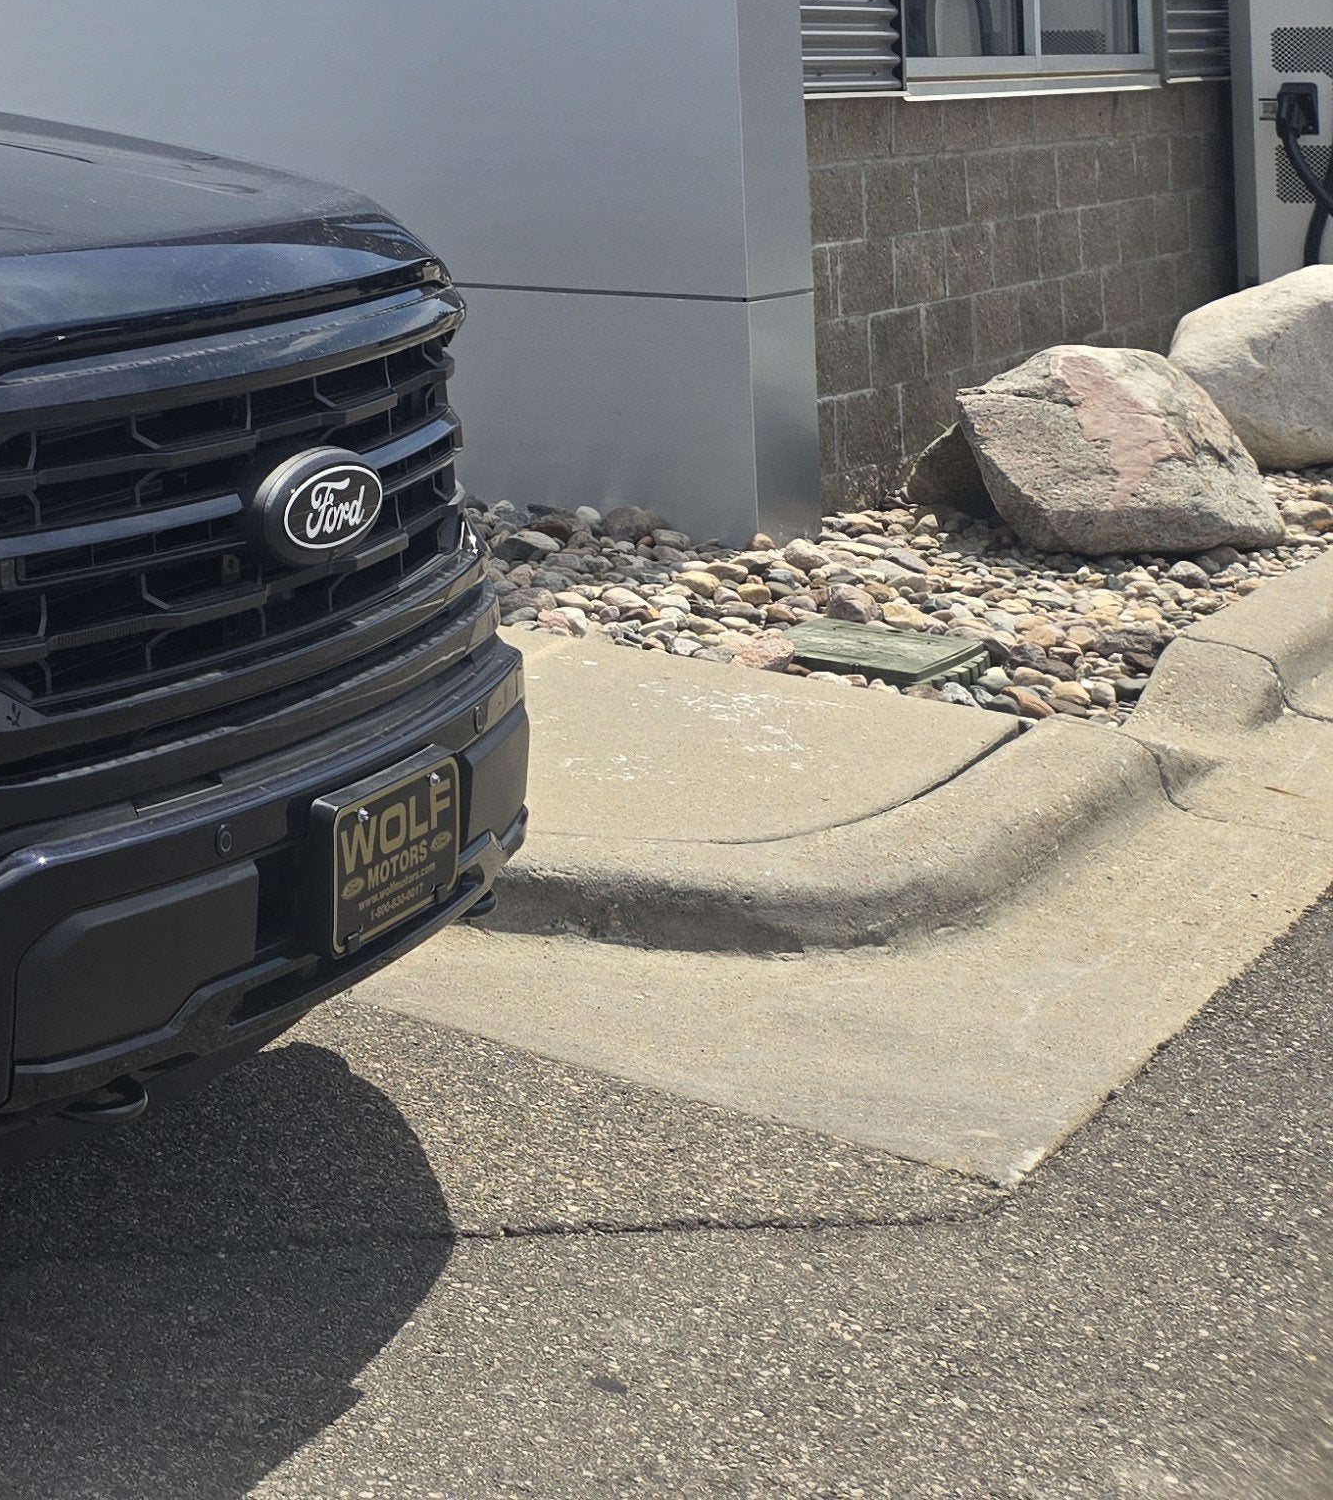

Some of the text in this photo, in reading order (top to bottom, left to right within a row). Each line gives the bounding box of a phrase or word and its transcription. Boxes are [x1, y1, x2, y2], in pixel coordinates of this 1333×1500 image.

[306, 478, 364, 540] Ford
[341, 778, 451, 875] WOLF
[358, 862, 436, 911] www.wolfmotors.com
[367, 839, 428, 891] MOTORS
